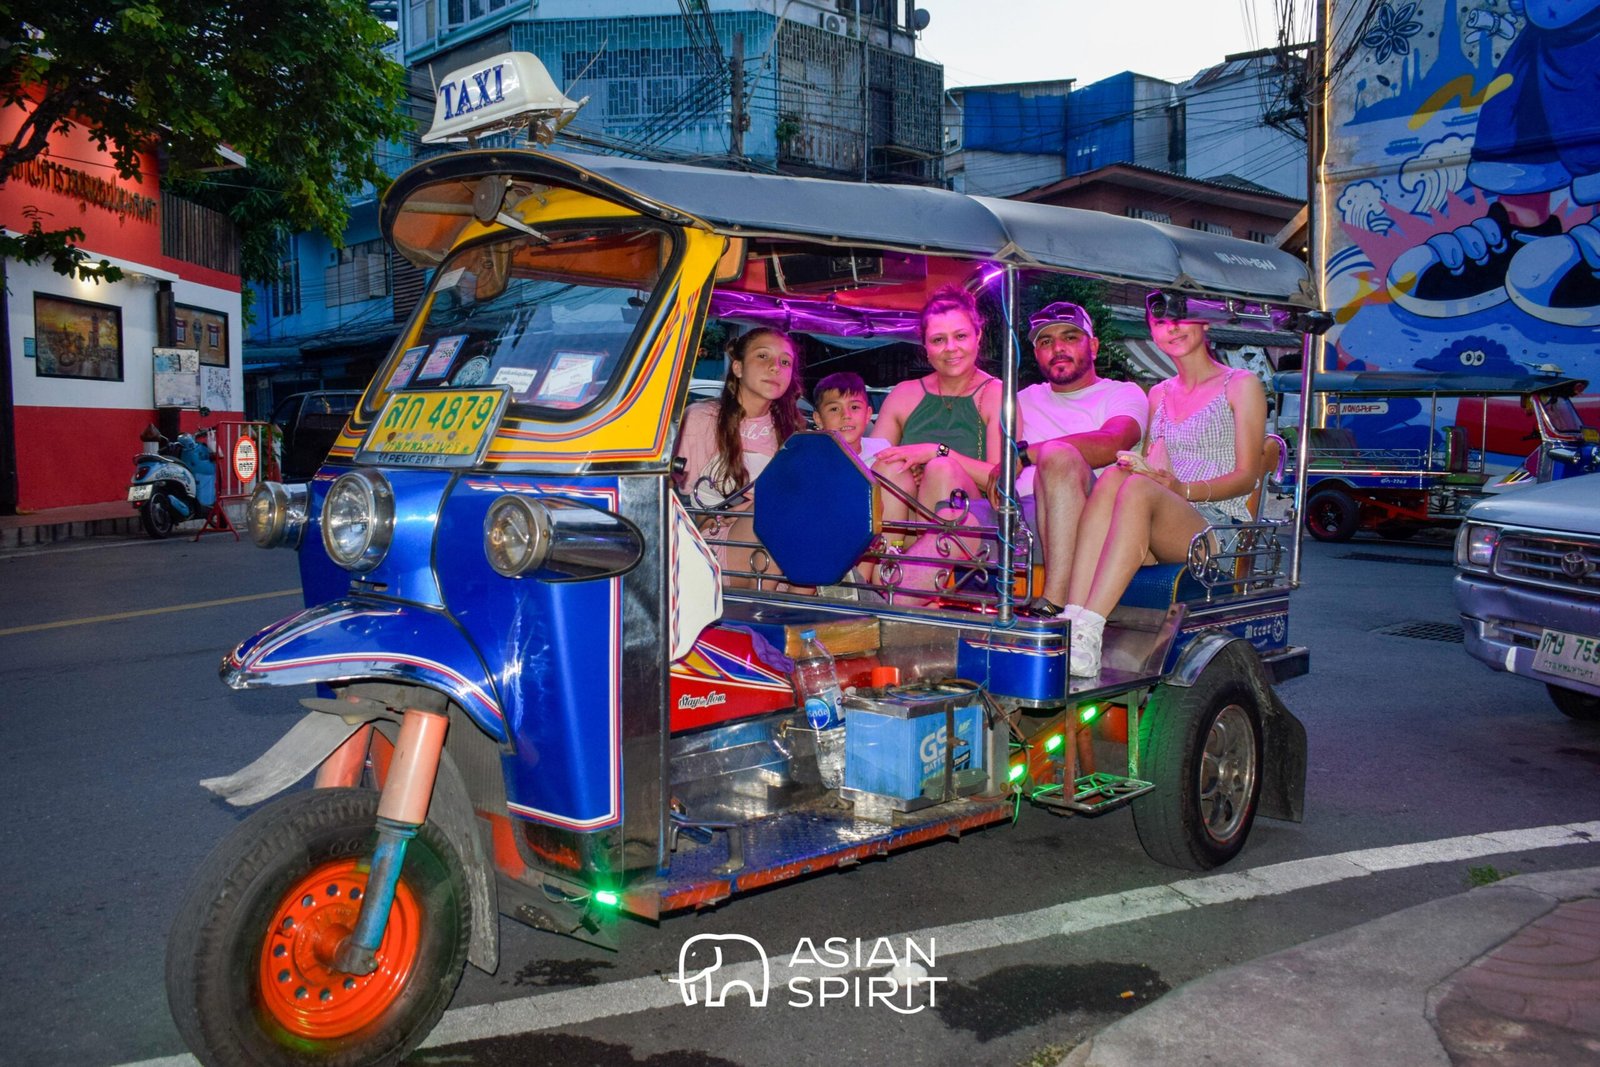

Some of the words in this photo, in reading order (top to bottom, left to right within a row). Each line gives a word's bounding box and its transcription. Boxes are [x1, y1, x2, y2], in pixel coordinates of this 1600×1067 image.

[439, 64, 505, 120] TAXI
[428, 395, 495, 430] 4879
[387, 454, 438, 464] PEUGEOT
[679, 694, 698, 708] Stay
[706, 691, 725, 706] flow
[923, 754, 947, 774] BATTE
